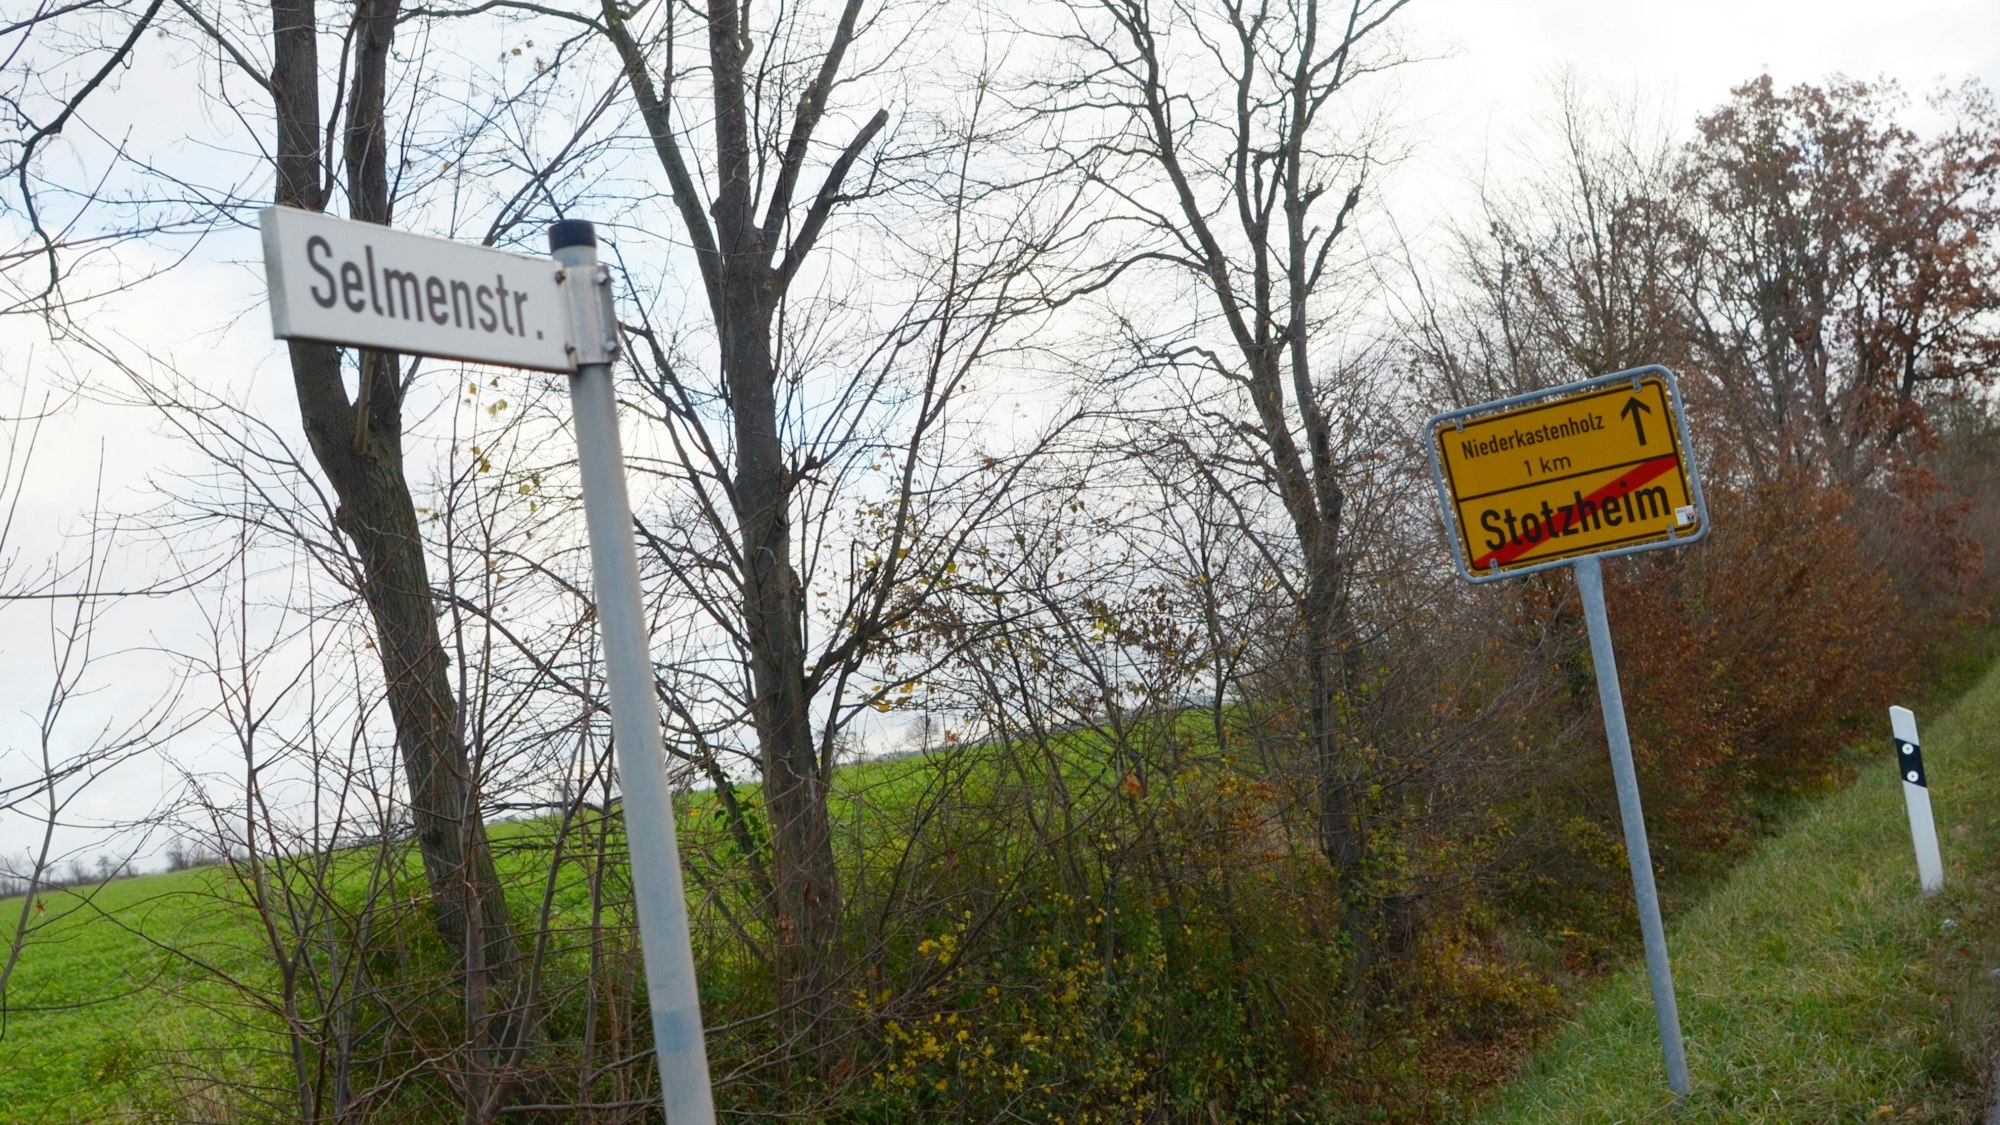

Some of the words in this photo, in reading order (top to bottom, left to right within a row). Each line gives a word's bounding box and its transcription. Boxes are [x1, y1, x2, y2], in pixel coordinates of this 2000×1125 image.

[306, 235, 544, 340] Selmenstr.
[1461, 412, 1605, 460] Niederkastenholz
[1523, 459, 1533, 477] 1
[1539, 454, 1572, 474] km
[1480, 480, 1671, 551] Stotzheim
